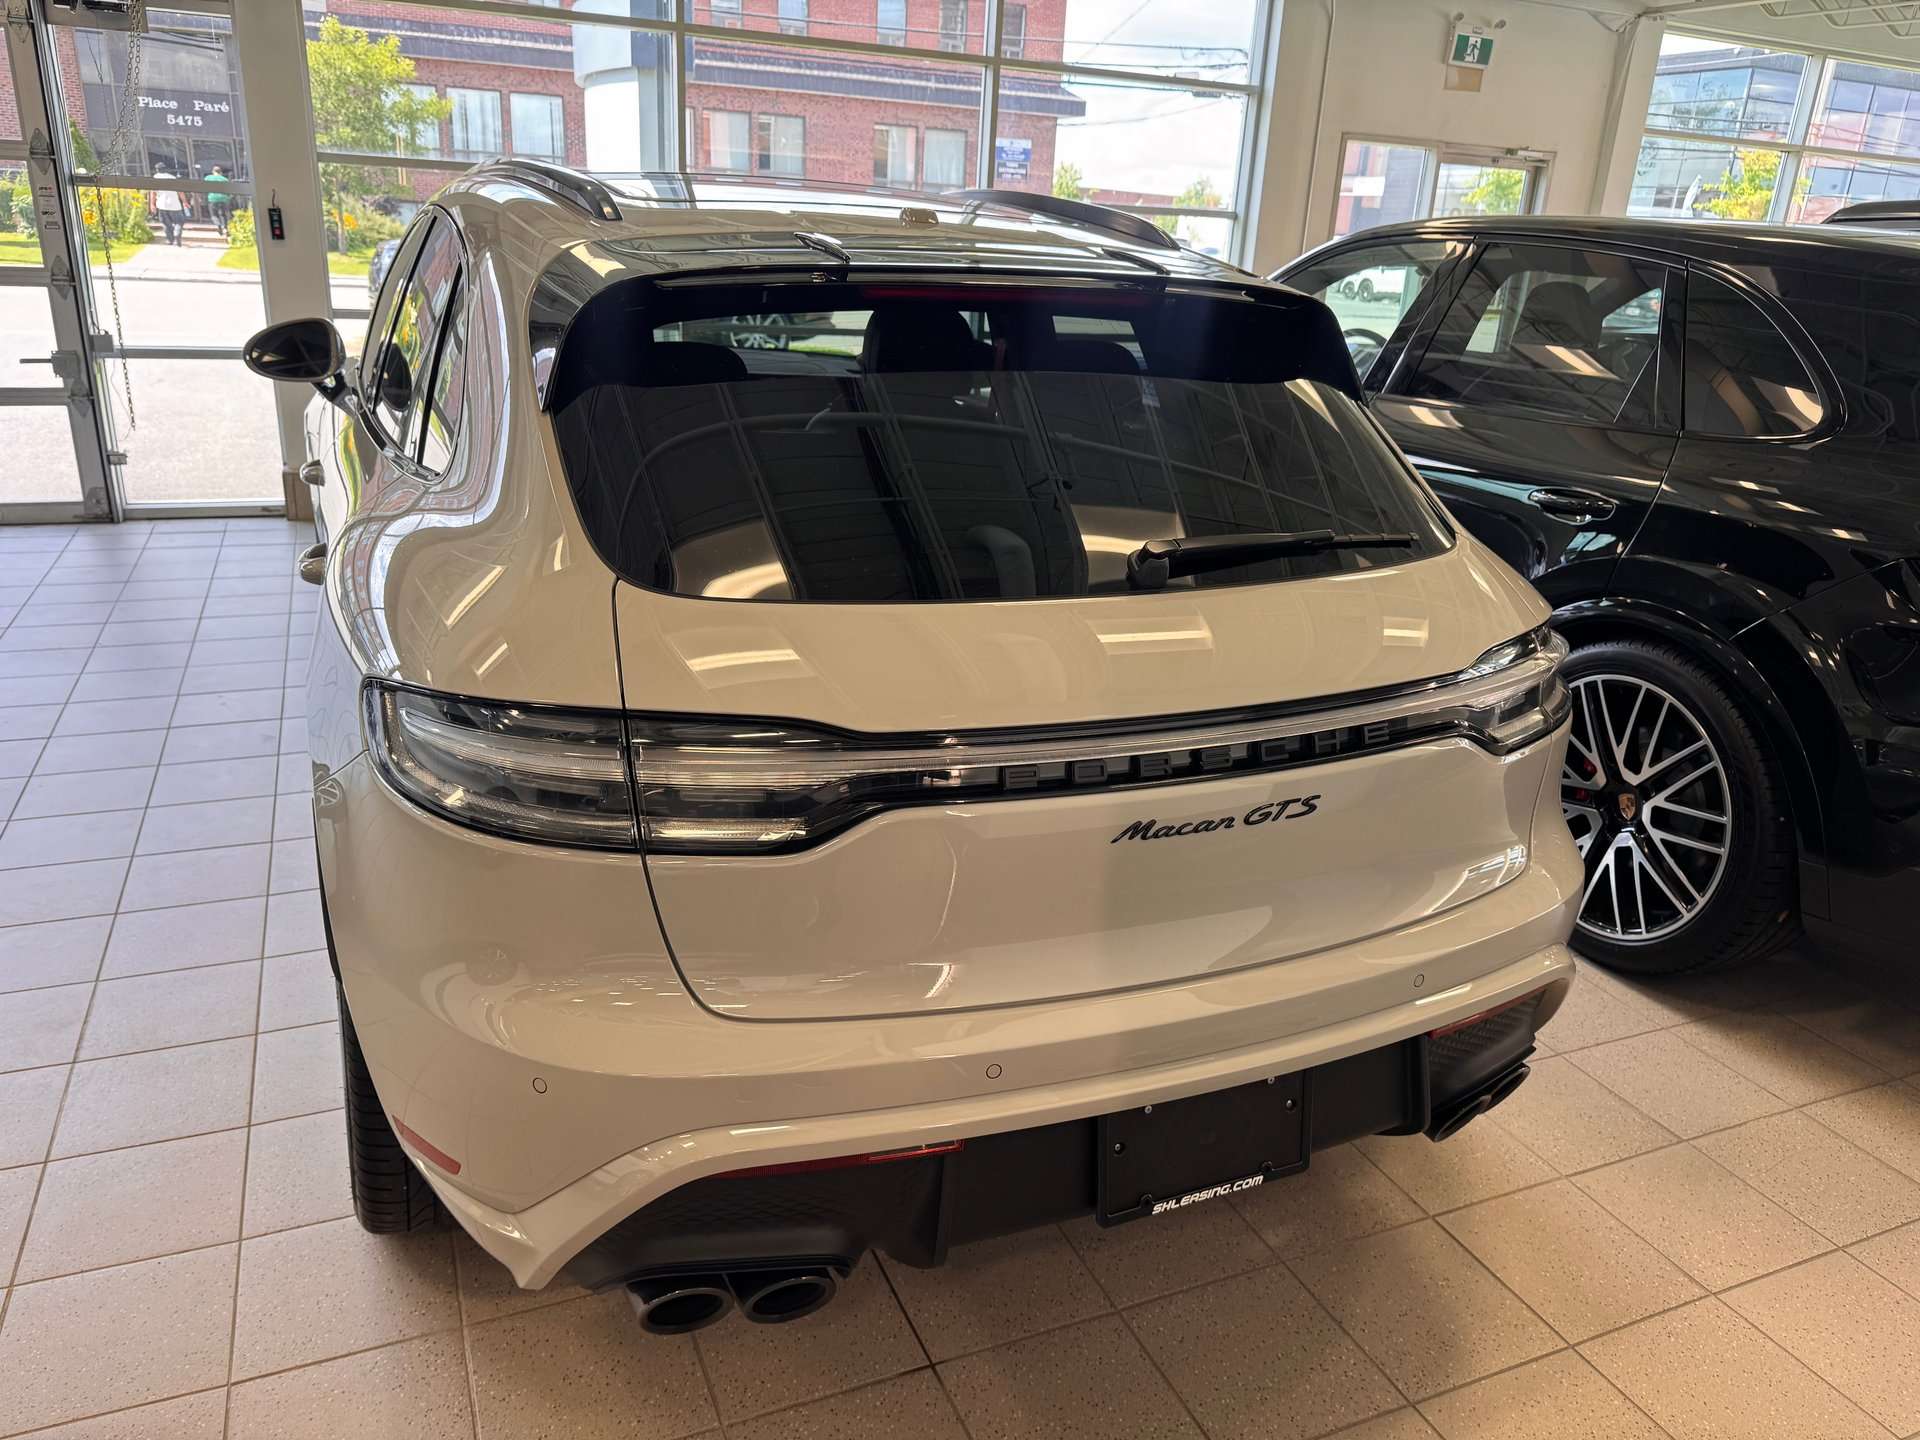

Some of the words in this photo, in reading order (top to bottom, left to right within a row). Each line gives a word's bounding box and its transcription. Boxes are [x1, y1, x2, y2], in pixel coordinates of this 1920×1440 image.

[137, 96, 178, 109] Place
[193, 100, 230, 113] Paré
[166, 114, 203, 127] 5475
[1003, 722, 1390, 790] PORSCHE
[1110, 815, 1235, 844] Macan
[1243, 794, 1322, 826] GTS
[1152, 1175, 1264, 1215] SHLEASING.COM
